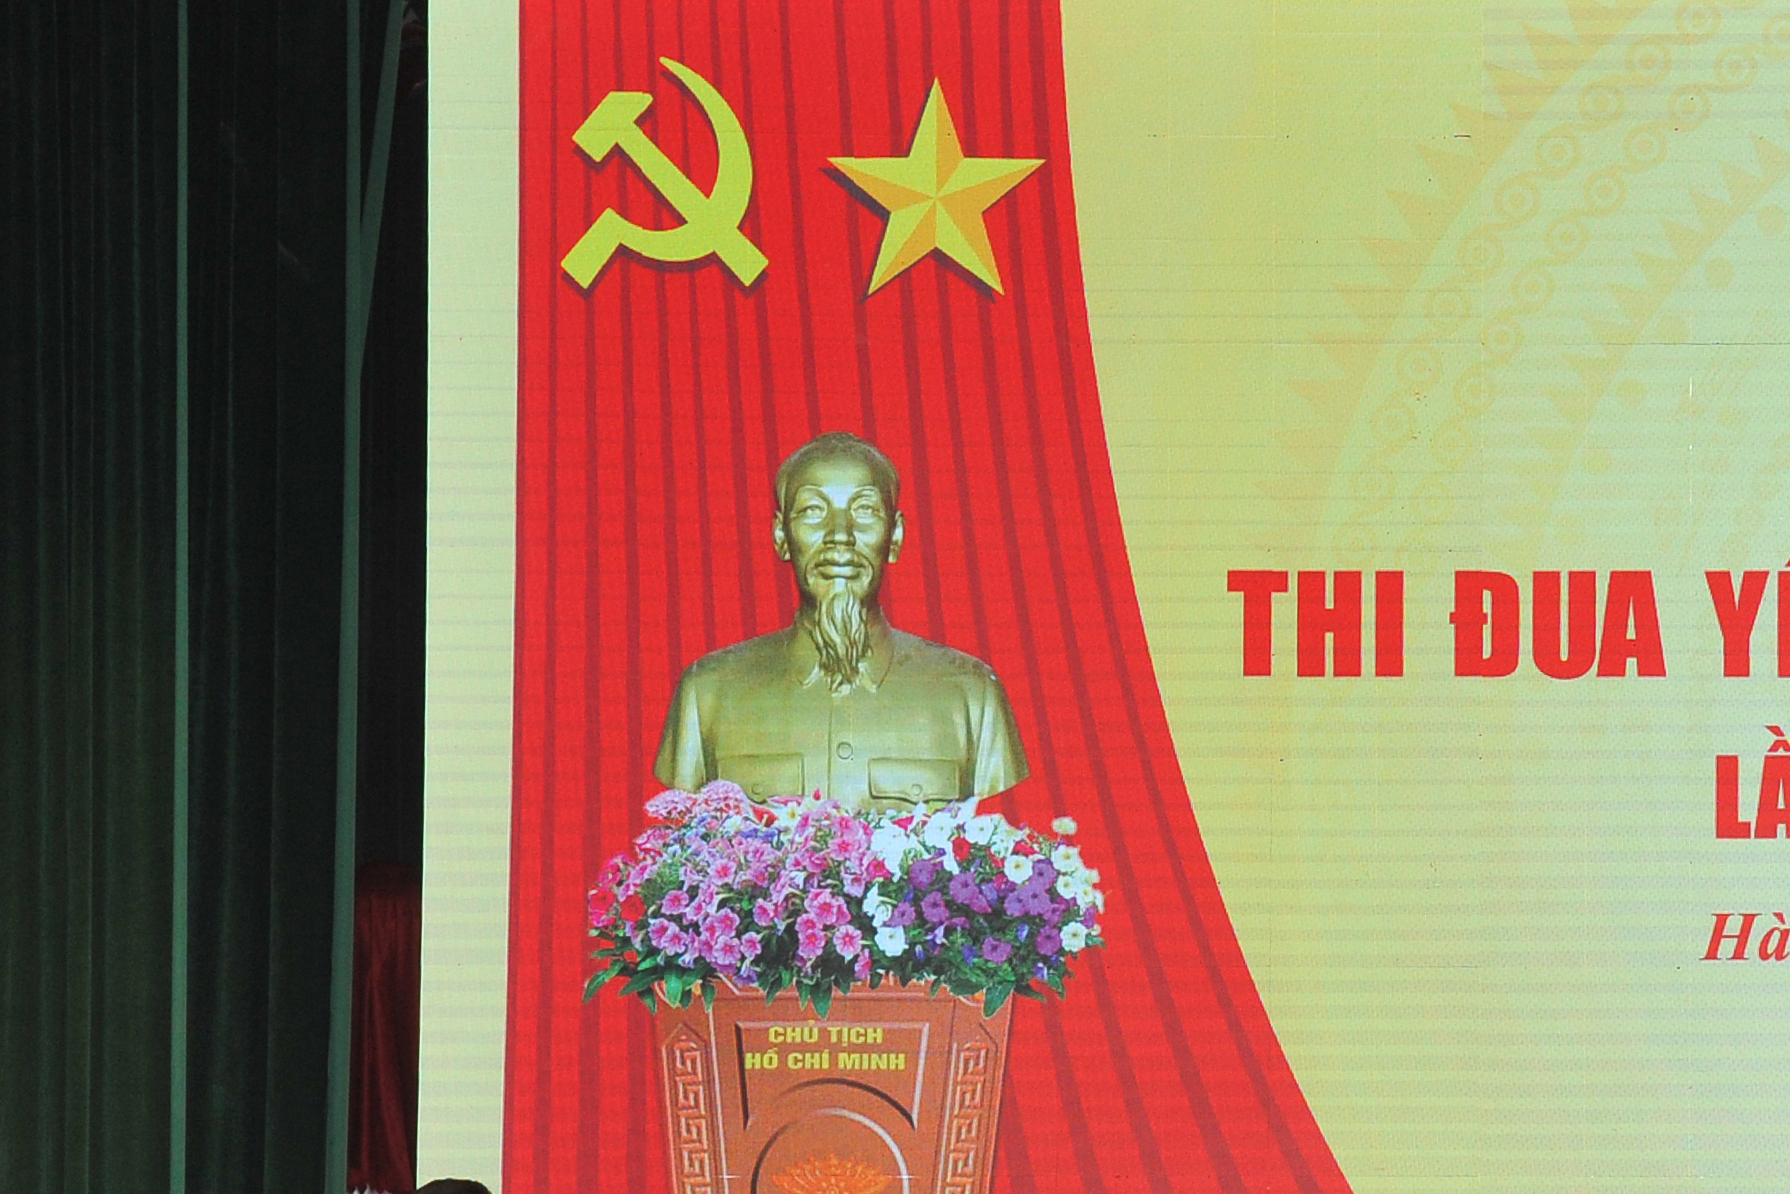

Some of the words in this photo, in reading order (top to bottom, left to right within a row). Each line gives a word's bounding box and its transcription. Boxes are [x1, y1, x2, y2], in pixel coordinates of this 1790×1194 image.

[1227, 569, 1405, 678] THI
[1449, 569, 1667, 680] ĐUA
[768, 1019, 819, 1044] CHỦ
[827, 1025, 884, 1047] TỊCH
[787, 1049, 830, 1070] CHÍ
[837, 1052, 906, 1070] MINH
